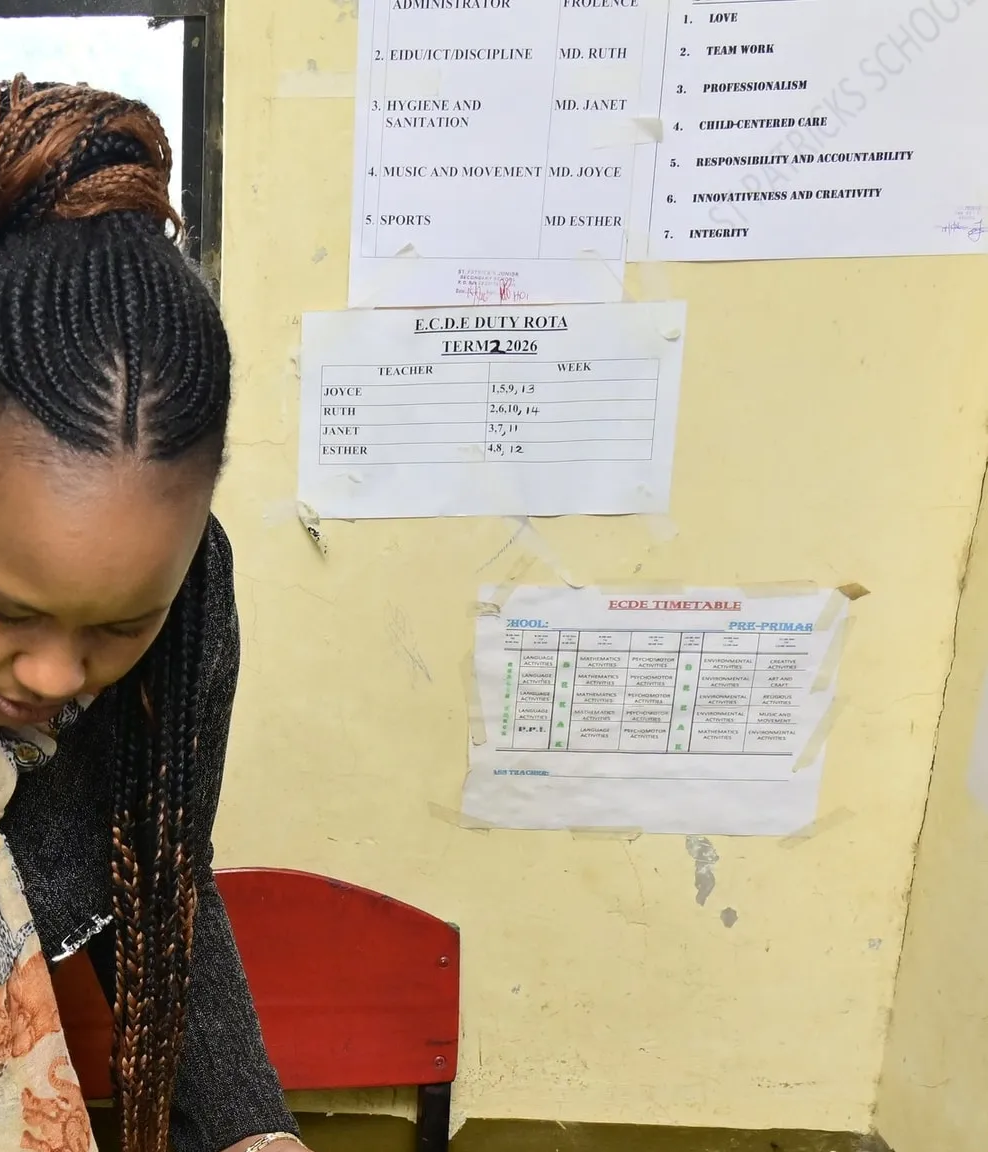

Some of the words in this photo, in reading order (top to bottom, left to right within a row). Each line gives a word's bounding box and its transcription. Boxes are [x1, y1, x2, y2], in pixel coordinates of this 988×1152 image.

[393, 0, 511, 10] ADMINISTRATOR
[683, 14, 693, 25] 1.
[709, 12, 738, 23] LOVE
[680, 47, 691, 57] 2.
[706, 45, 738, 56] TEAM
[740, 43, 775, 55] WORK
[859, 0, 977, 92] SCHOO
[375, 50, 384, 61] 2.
[390, 49, 533, 61] EIDU/ICT/DISCIPLINE
[560, 48, 584, 59] MD.
[588, 47, 627, 59] RUTH
[676, 84, 687, 94] 3.
[702, 80, 808, 93] PROFESSIONALISM
[372, 101, 381, 111] 3.
[387, 100, 449, 112] HYGIENE
[453, 100, 481, 111] AND
[554, 100, 579, 111] MD.
[582, 99, 627, 111] JANET
[386, 117, 470, 128] SANITATION
[673, 122, 684, 132] 4.
[698, 118, 796, 131] CHILD-CENTERED
[797, 117, 828, 128] CARE
[669, 158, 680, 168] 5.
[696, 154, 789, 168] RESPONSIBILITY
[791, 153, 815, 165] AND
[816, 151, 914, 163] ACCOUNTABILITY
[368, 167, 377, 178] 4.
[383, 167, 427, 177] MUSIC
[430, 167, 458, 177] AND
[462, 166, 542, 177] MOVEMENT
[548, 167, 572, 178] MD.
[576, 167, 622, 178] JOYCE
[666, 194, 677, 204] 6.
[692, 191, 788, 204] INNOVATIVENESS
[790, 190, 814, 201] AND
[815, 188, 882, 200] CREATIVITY
[365, 215, 375, 226] 5.
[380, 214, 431, 226] SPORTS
[544, 215, 566, 227] MD
[569, 215, 622, 227] ESTHER
[663, 230, 673, 239] 7.
[689, 228, 750, 239] INTEGRITY
[415, 317, 470, 331] E.C.D.E
[475, 316, 520, 330] DUTY
[524, 315, 568, 329] ROTA
[506, 340, 538, 353] 2026
[378, 365, 433, 376] TEACHER
[557, 362, 592, 373] WEEK
[323, 387, 362, 398] JOYCE
[323, 407, 356, 417] RUTH
[322, 425, 360, 436] JANET
[322, 445, 368, 456] ESTHER
[609, 600, 648, 610] ECDE
[654, 600, 741, 611] TIMETABLE
